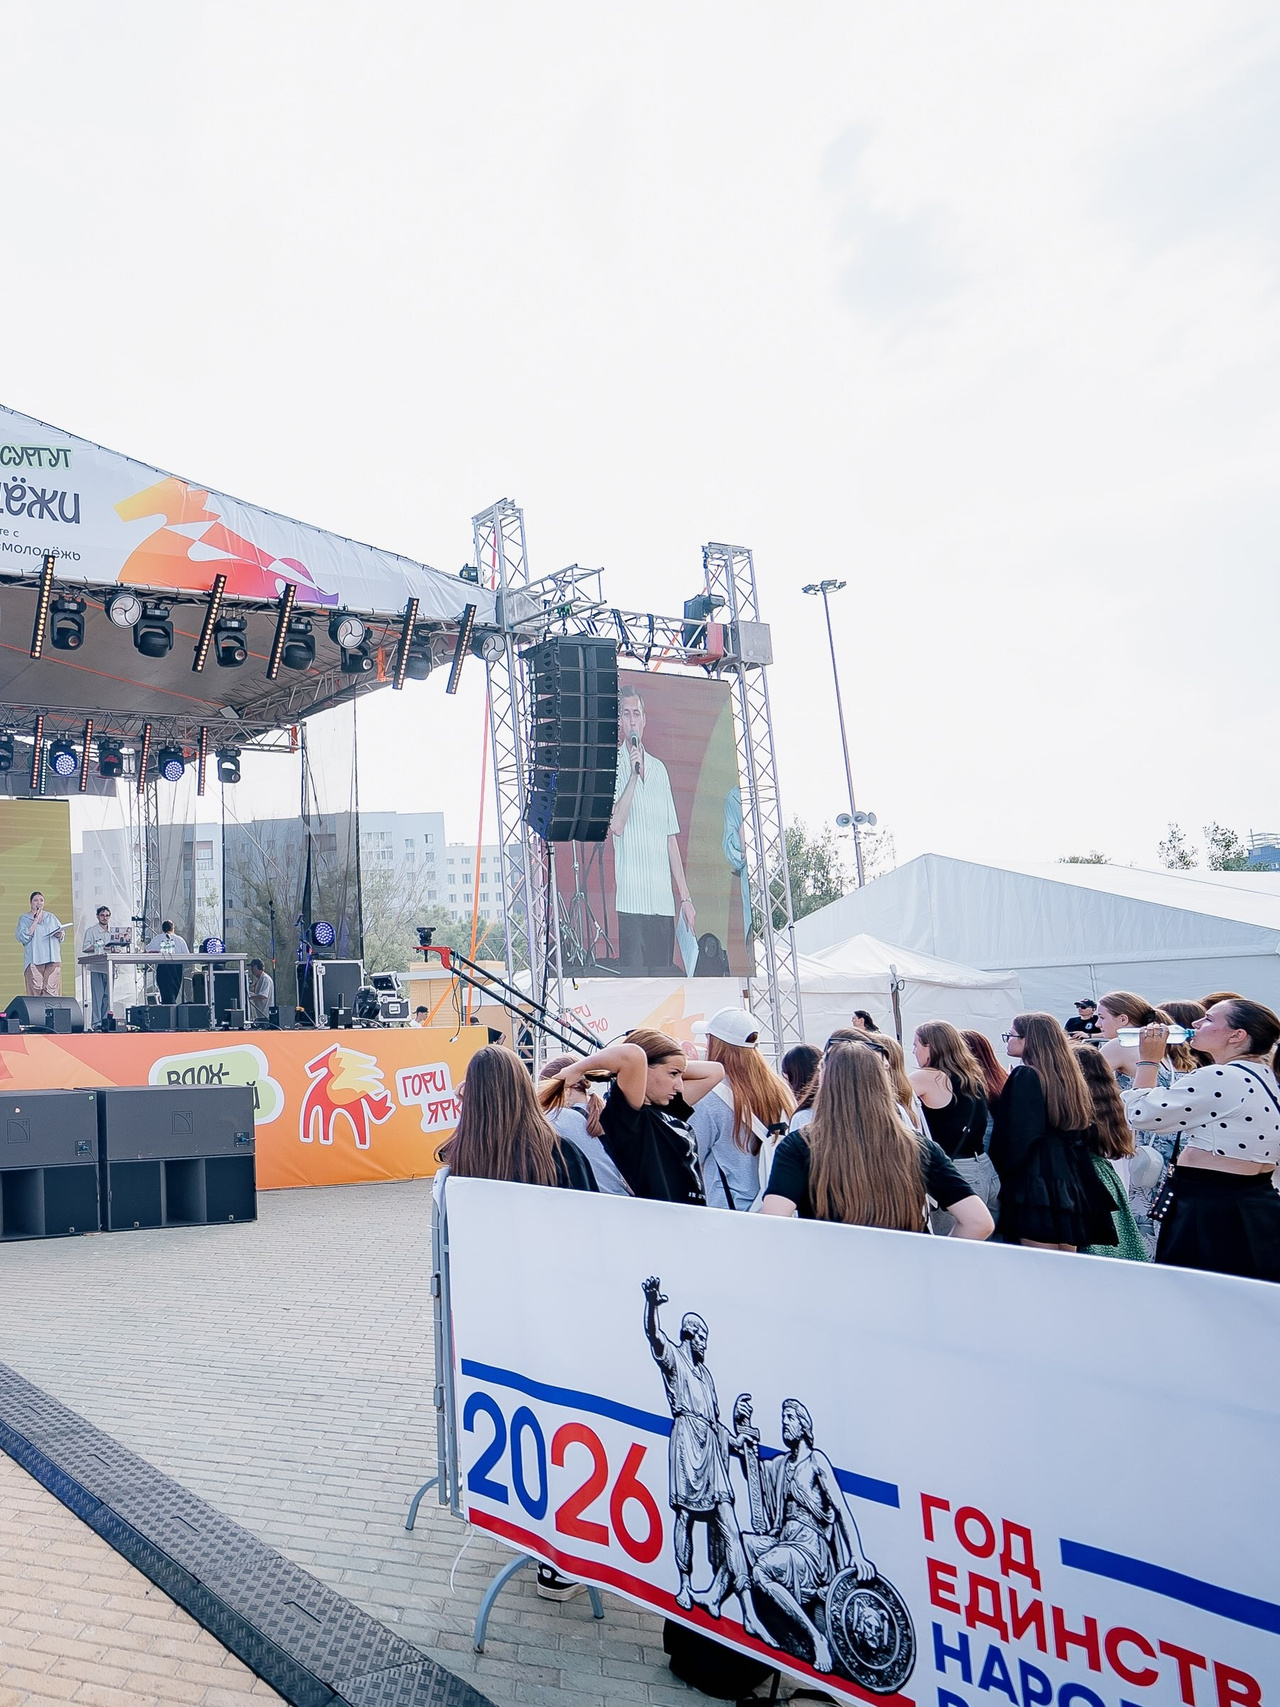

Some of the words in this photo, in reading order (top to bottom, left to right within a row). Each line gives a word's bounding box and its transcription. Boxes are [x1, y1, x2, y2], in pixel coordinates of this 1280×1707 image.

[0, 445, 71, 468] СУРГУТ
[13, 530, 19, 538] с
[401, 1069, 446, 1098] ГОРИ
[427, 1098, 461, 1124] ЯРК
[463, 1391, 664, 1564] 2026
[920, 1491, 1042, 1593] ГОД
